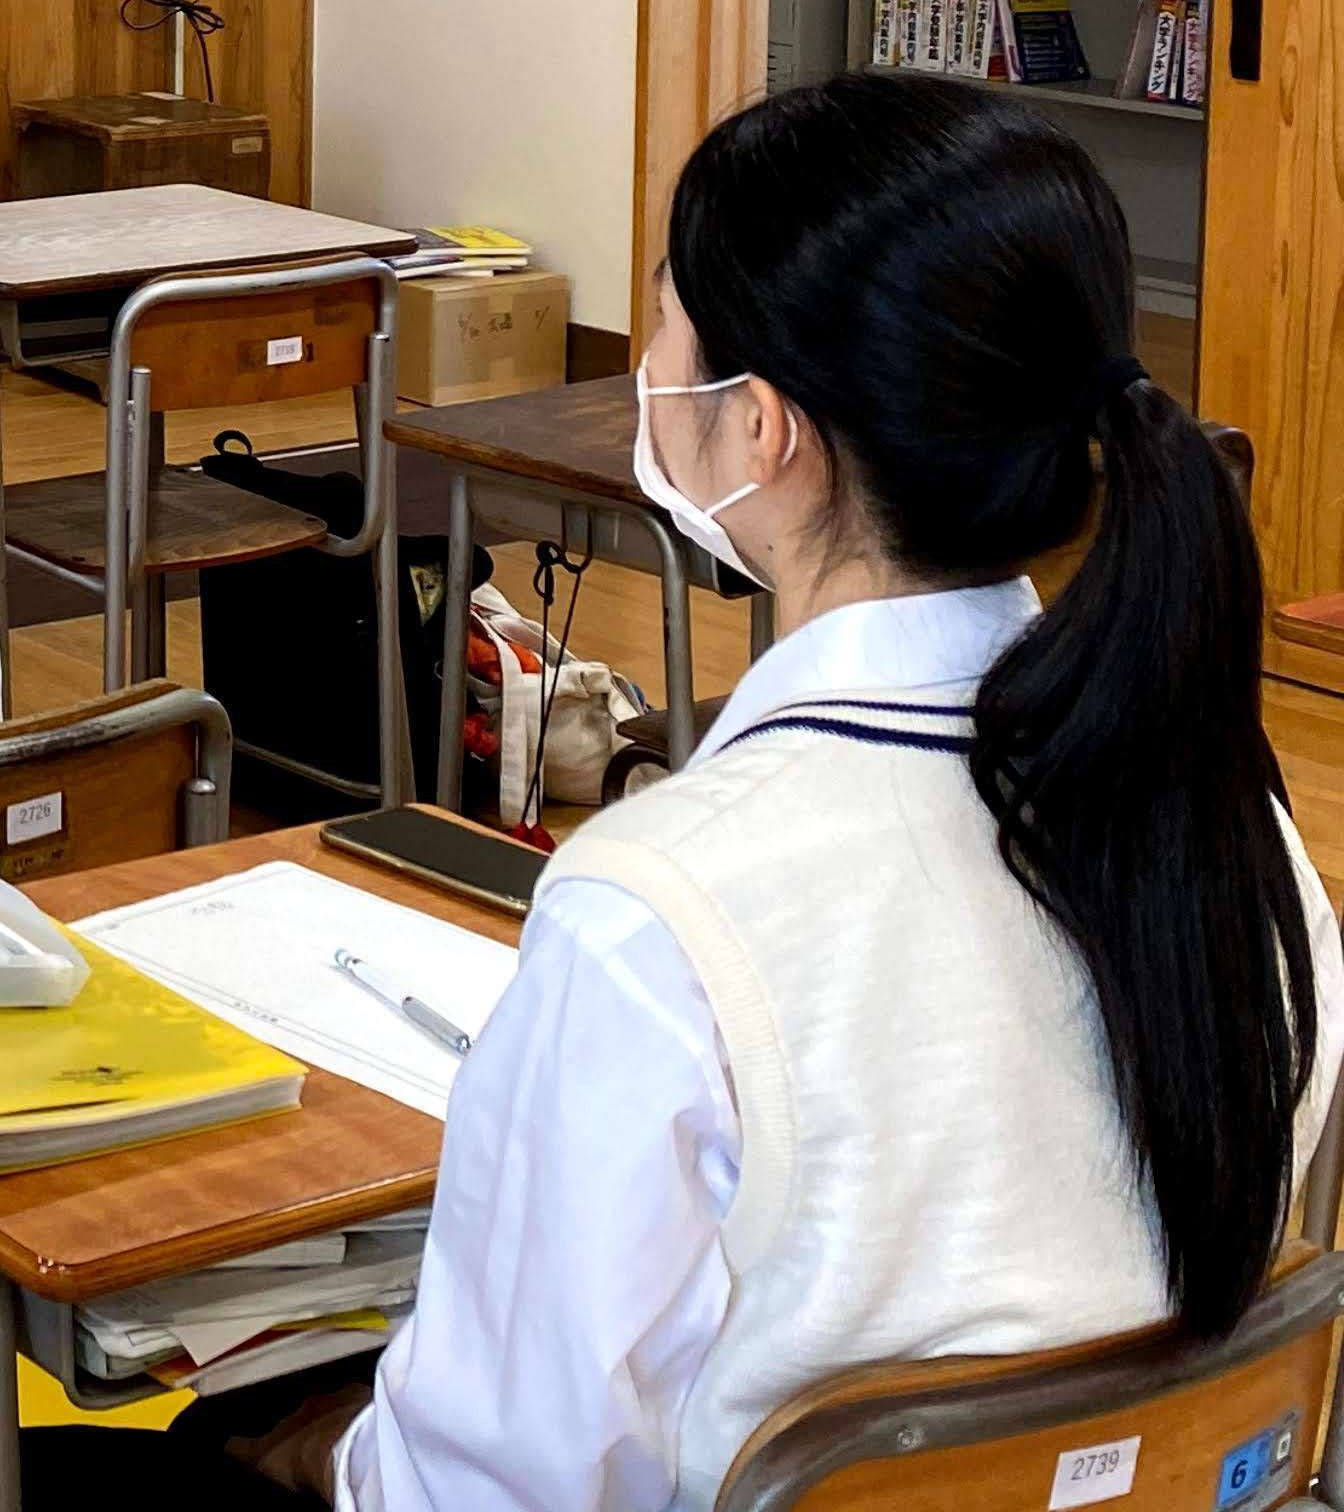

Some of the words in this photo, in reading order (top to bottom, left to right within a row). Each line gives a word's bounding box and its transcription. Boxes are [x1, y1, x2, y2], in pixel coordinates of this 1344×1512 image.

[19, 802, 52, 825] 2726
[1070, 1449, 1121, 1481] 2739
[1230, 1459, 1249, 1489] 6
